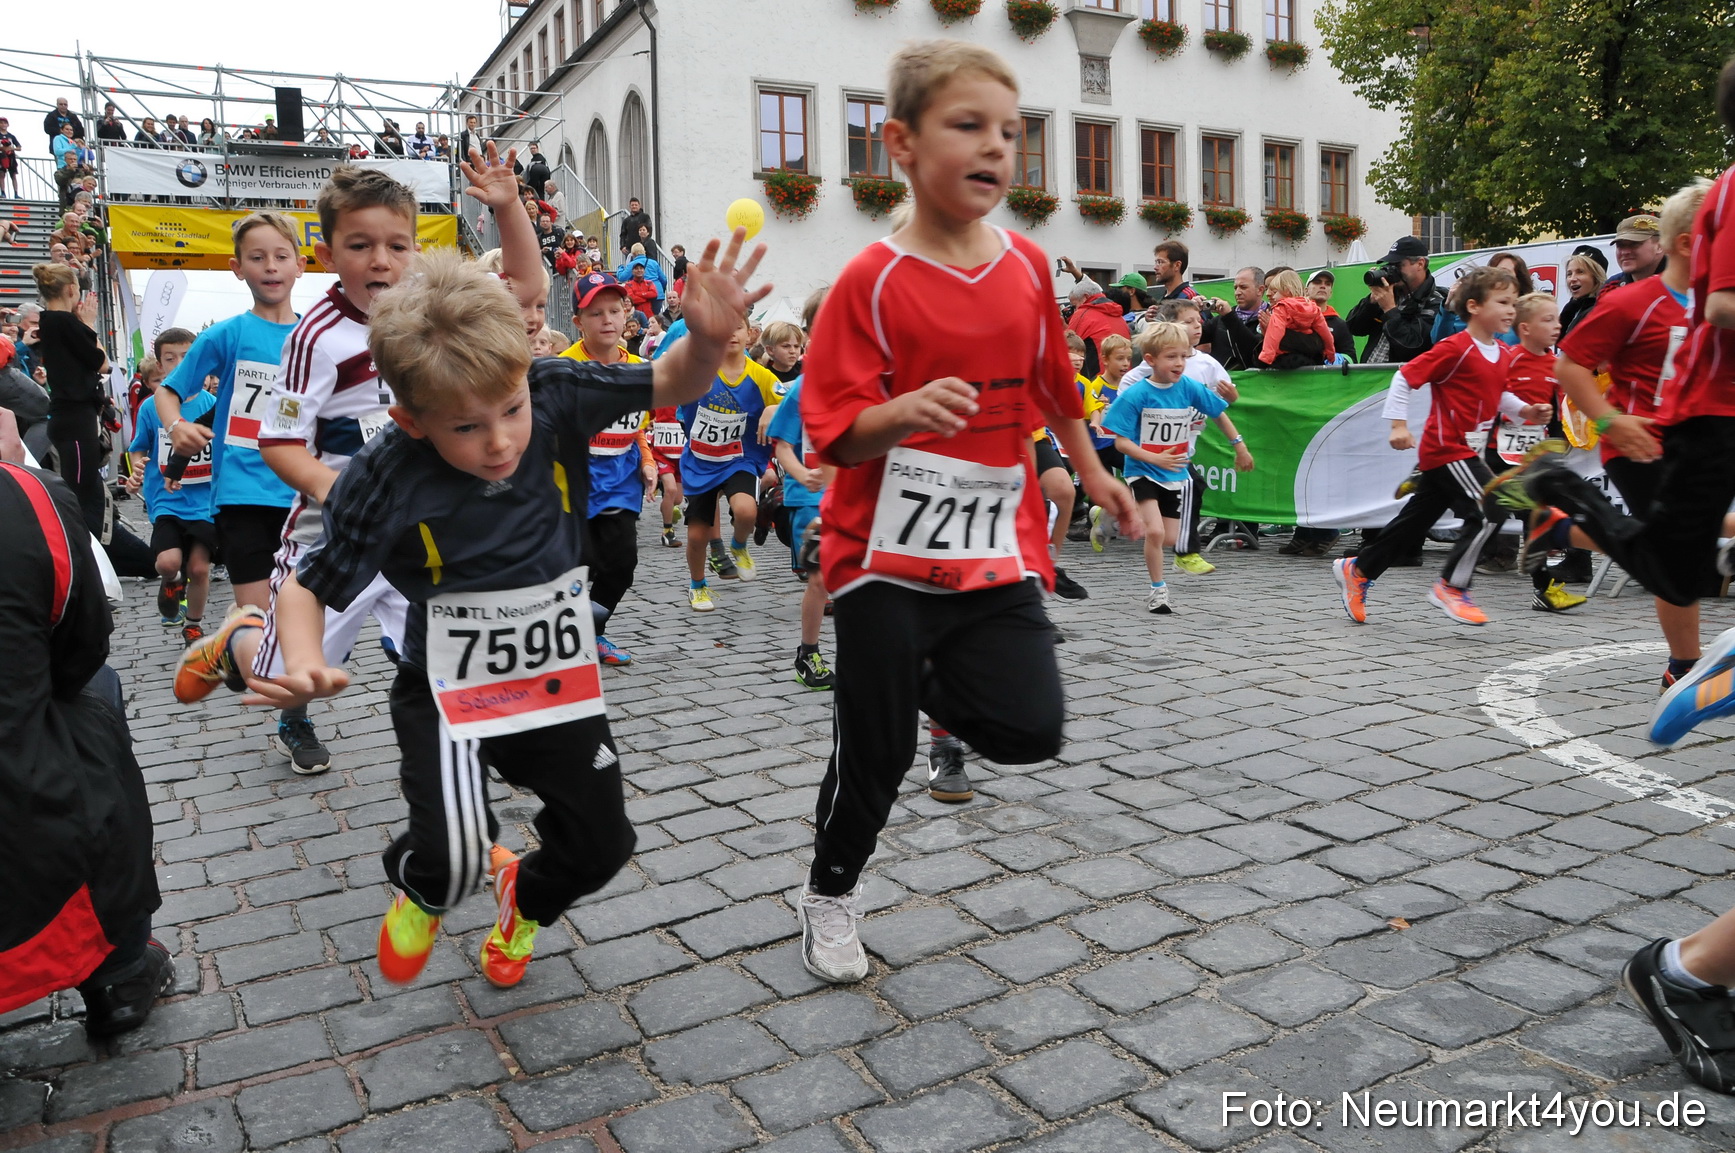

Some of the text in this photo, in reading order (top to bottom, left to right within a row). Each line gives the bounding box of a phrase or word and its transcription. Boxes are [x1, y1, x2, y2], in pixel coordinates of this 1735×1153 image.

[215, 163, 332, 179] BMW EfficientD
[216, 178, 257, 189] Weniger
[258, 180, 311, 190] Verbrauch.
[131, 230, 210, 240] Neumarkter Stadtlauf
[238, 368, 270, 382] PARTL
[244, 382, 272, 414] 7
[608, 410, 640, 430] 43
[1143, 412, 1164, 421] PARTL
[591, 433, 634, 446] Alexand
[658, 431, 686, 445] 7017
[697, 420, 741, 443] 7514
[1148, 421, 1188, 442] 7071
[165, 441, 212, 463] 799
[1505, 433, 1542, 452] 755
[889, 462, 947, 487] PARTL
[896, 489, 1006, 550] 7211
[497, 591, 566, 619] Neumar
[448, 607, 581, 680] 7596
